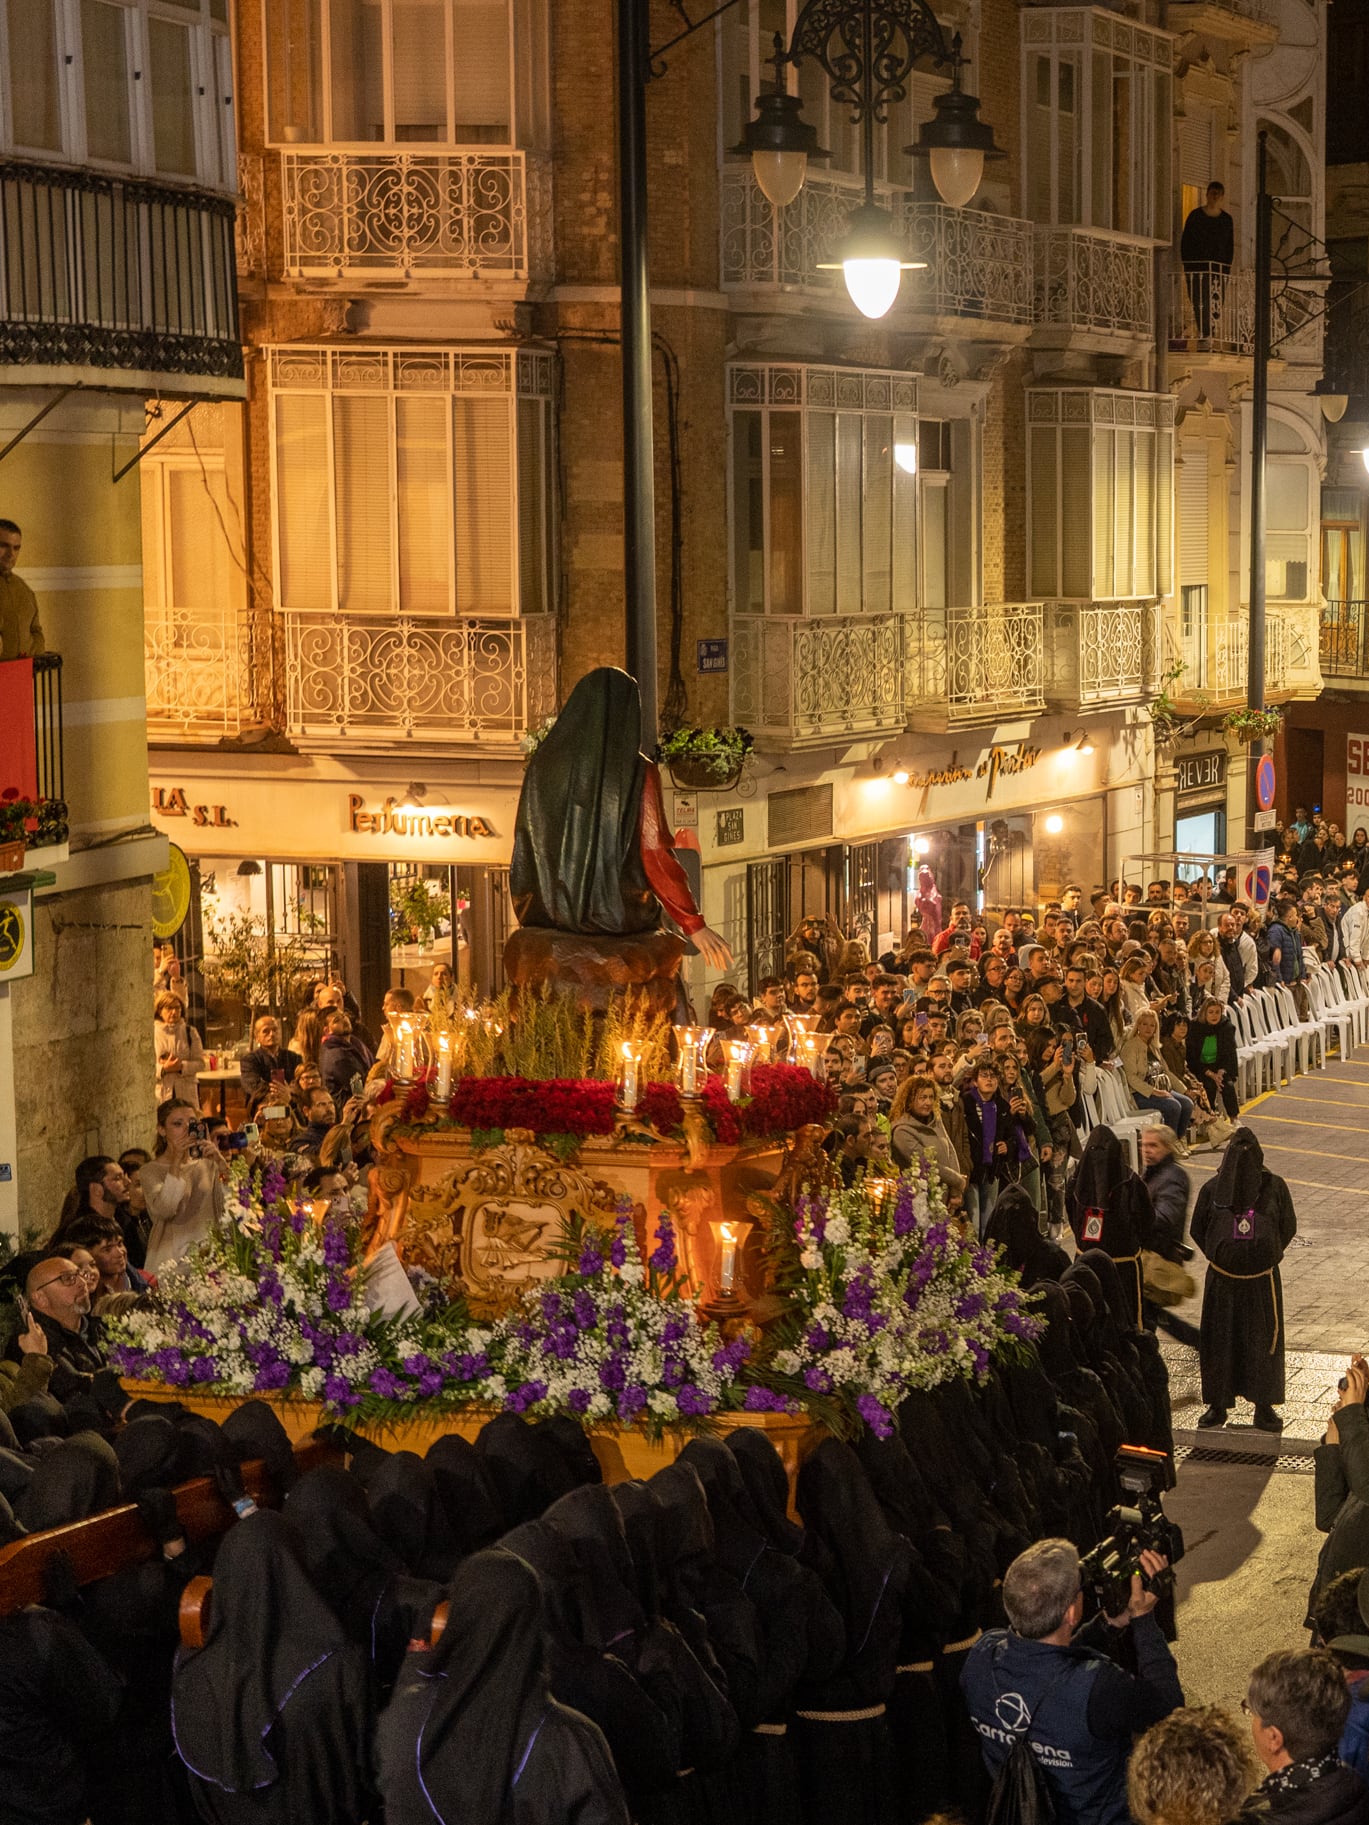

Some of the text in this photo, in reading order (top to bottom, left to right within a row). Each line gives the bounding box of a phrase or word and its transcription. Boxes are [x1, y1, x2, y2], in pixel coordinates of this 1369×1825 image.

[192, 805, 239, 827] S.L.
[726, 811, 742, 821] PLAZA
[727, 821, 738, 831] SAN
